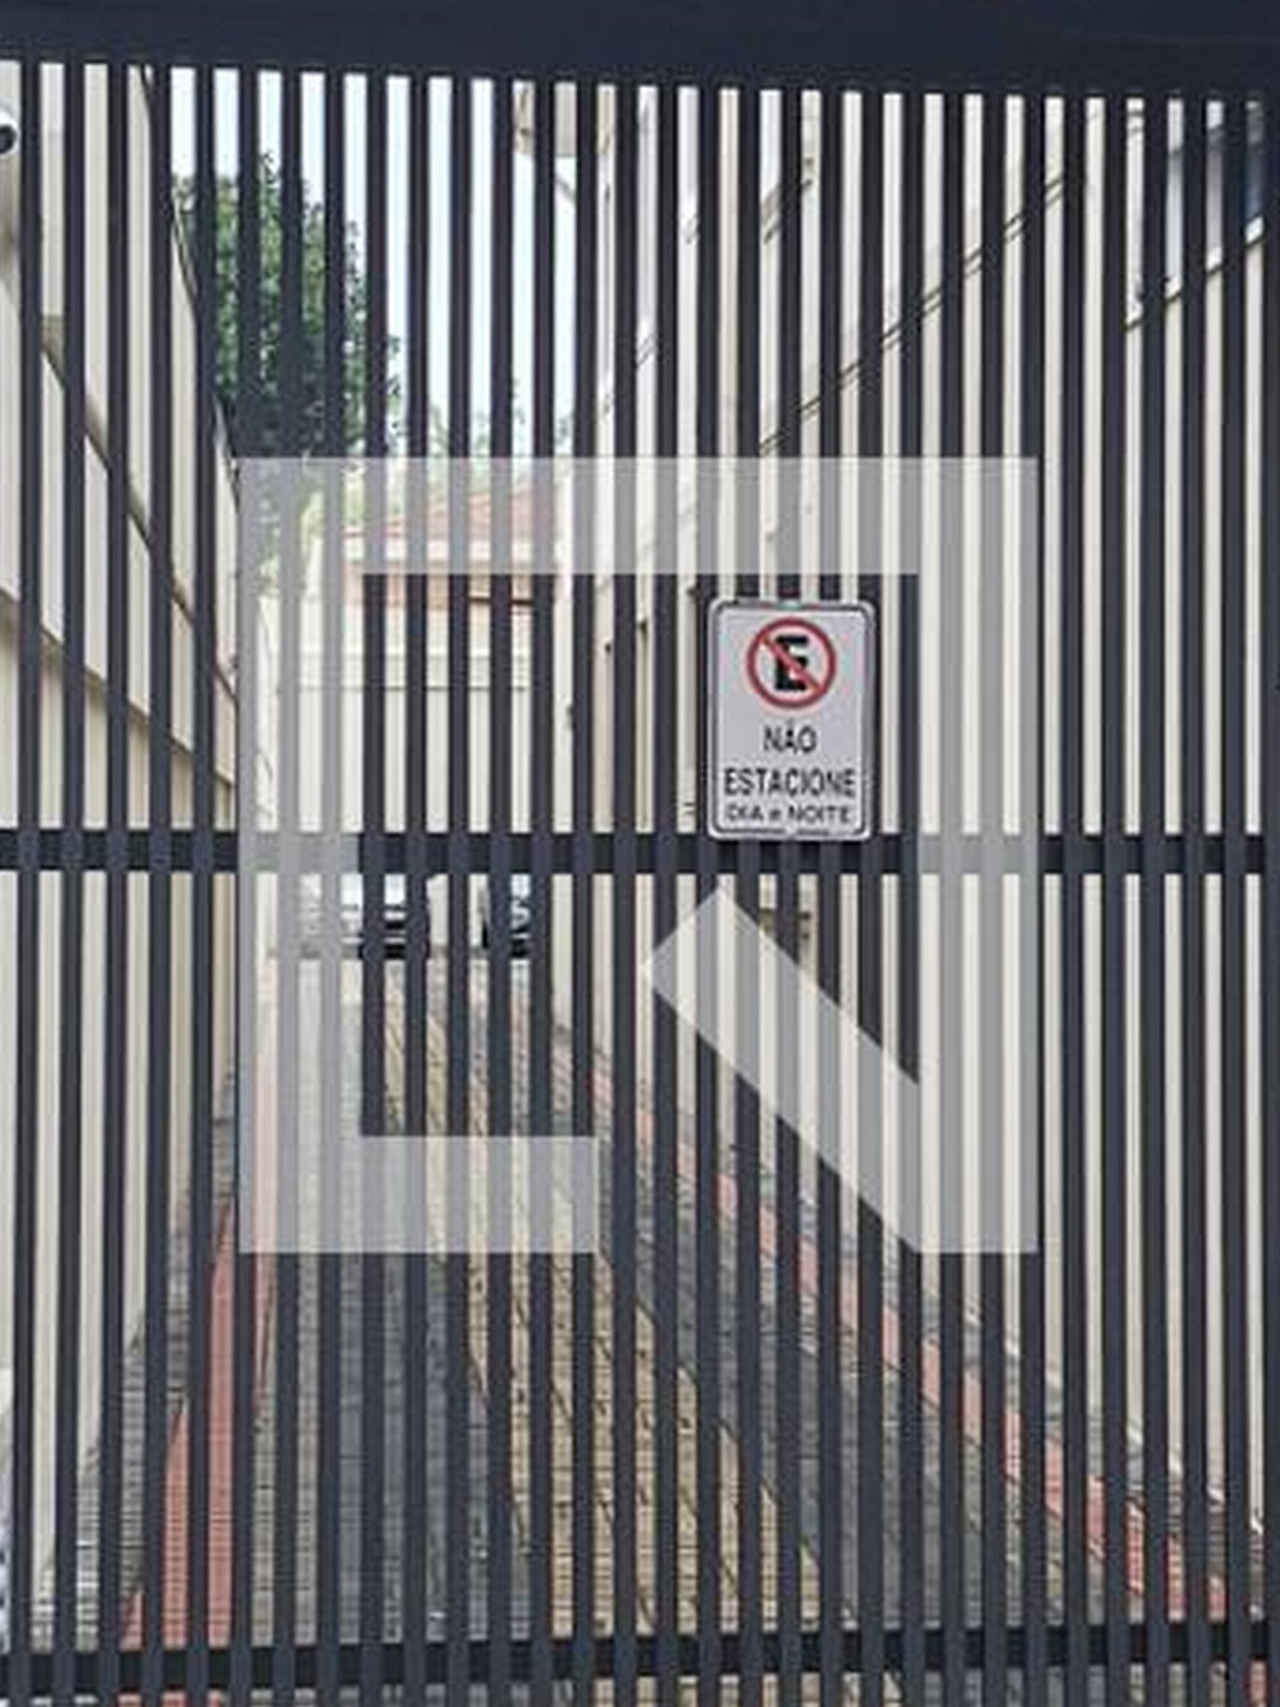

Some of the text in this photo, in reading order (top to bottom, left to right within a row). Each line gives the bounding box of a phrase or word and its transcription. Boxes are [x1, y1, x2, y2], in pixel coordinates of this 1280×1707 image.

[762, 719, 817, 754] NÃO
[723, 767, 856, 796] ESTACIONE
[727, 805, 764, 822] DIA
[788, 805, 851, 823] NOITE
